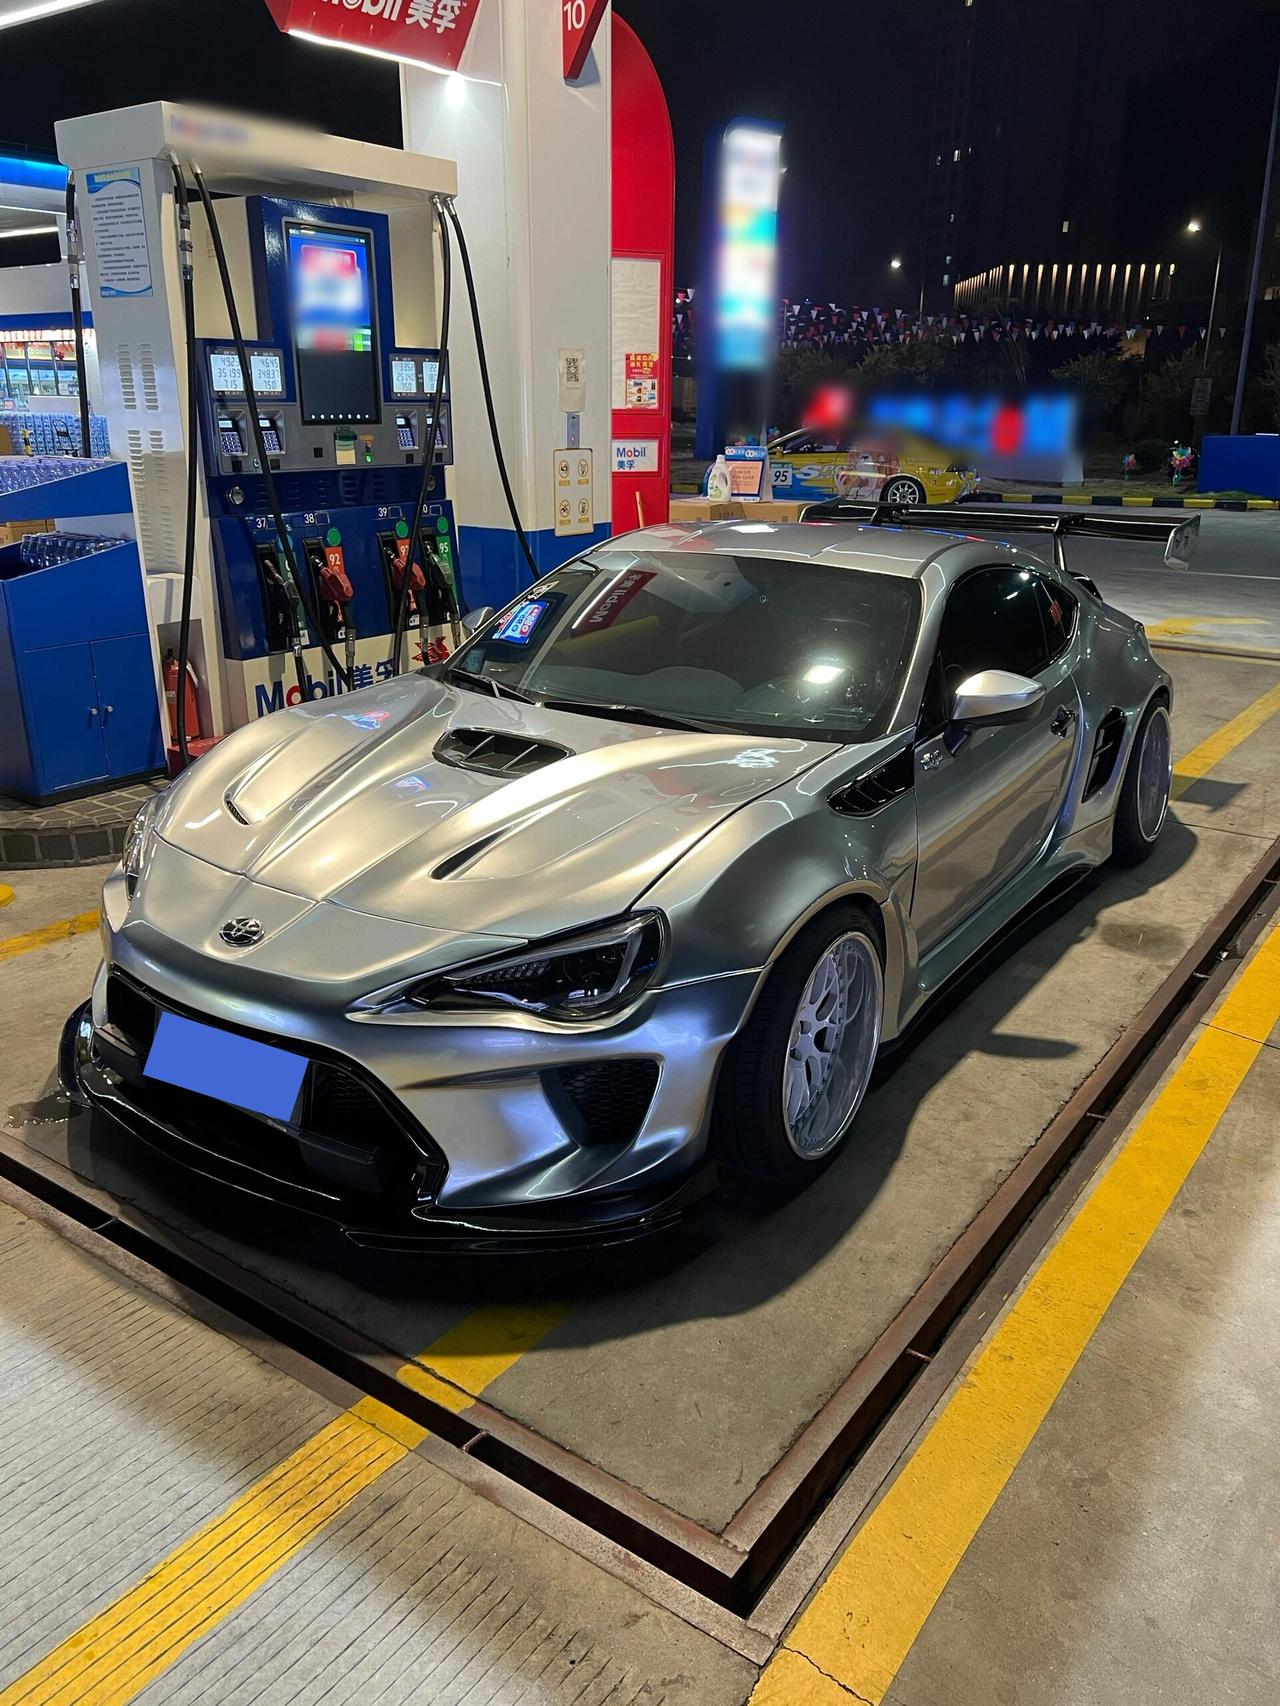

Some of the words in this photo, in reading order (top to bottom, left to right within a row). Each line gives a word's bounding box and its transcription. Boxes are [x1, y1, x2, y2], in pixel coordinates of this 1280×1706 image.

[321, 0, 400, 22] obil
[563, 0, 586, 31] 10
[616, 447, 646, 458] Mobil
[616, 459, 636, 470] 美孚
[774, 470, 789, 483] 95
[378, 506, 388, 518] 39
[256, 517, 267, 528] 37
[304, 513, 315, 524] 38
[439, 542, 449, 554] 95
[329, 553, 341, 566] 92
[255, 669, 344, 718] Mobil
